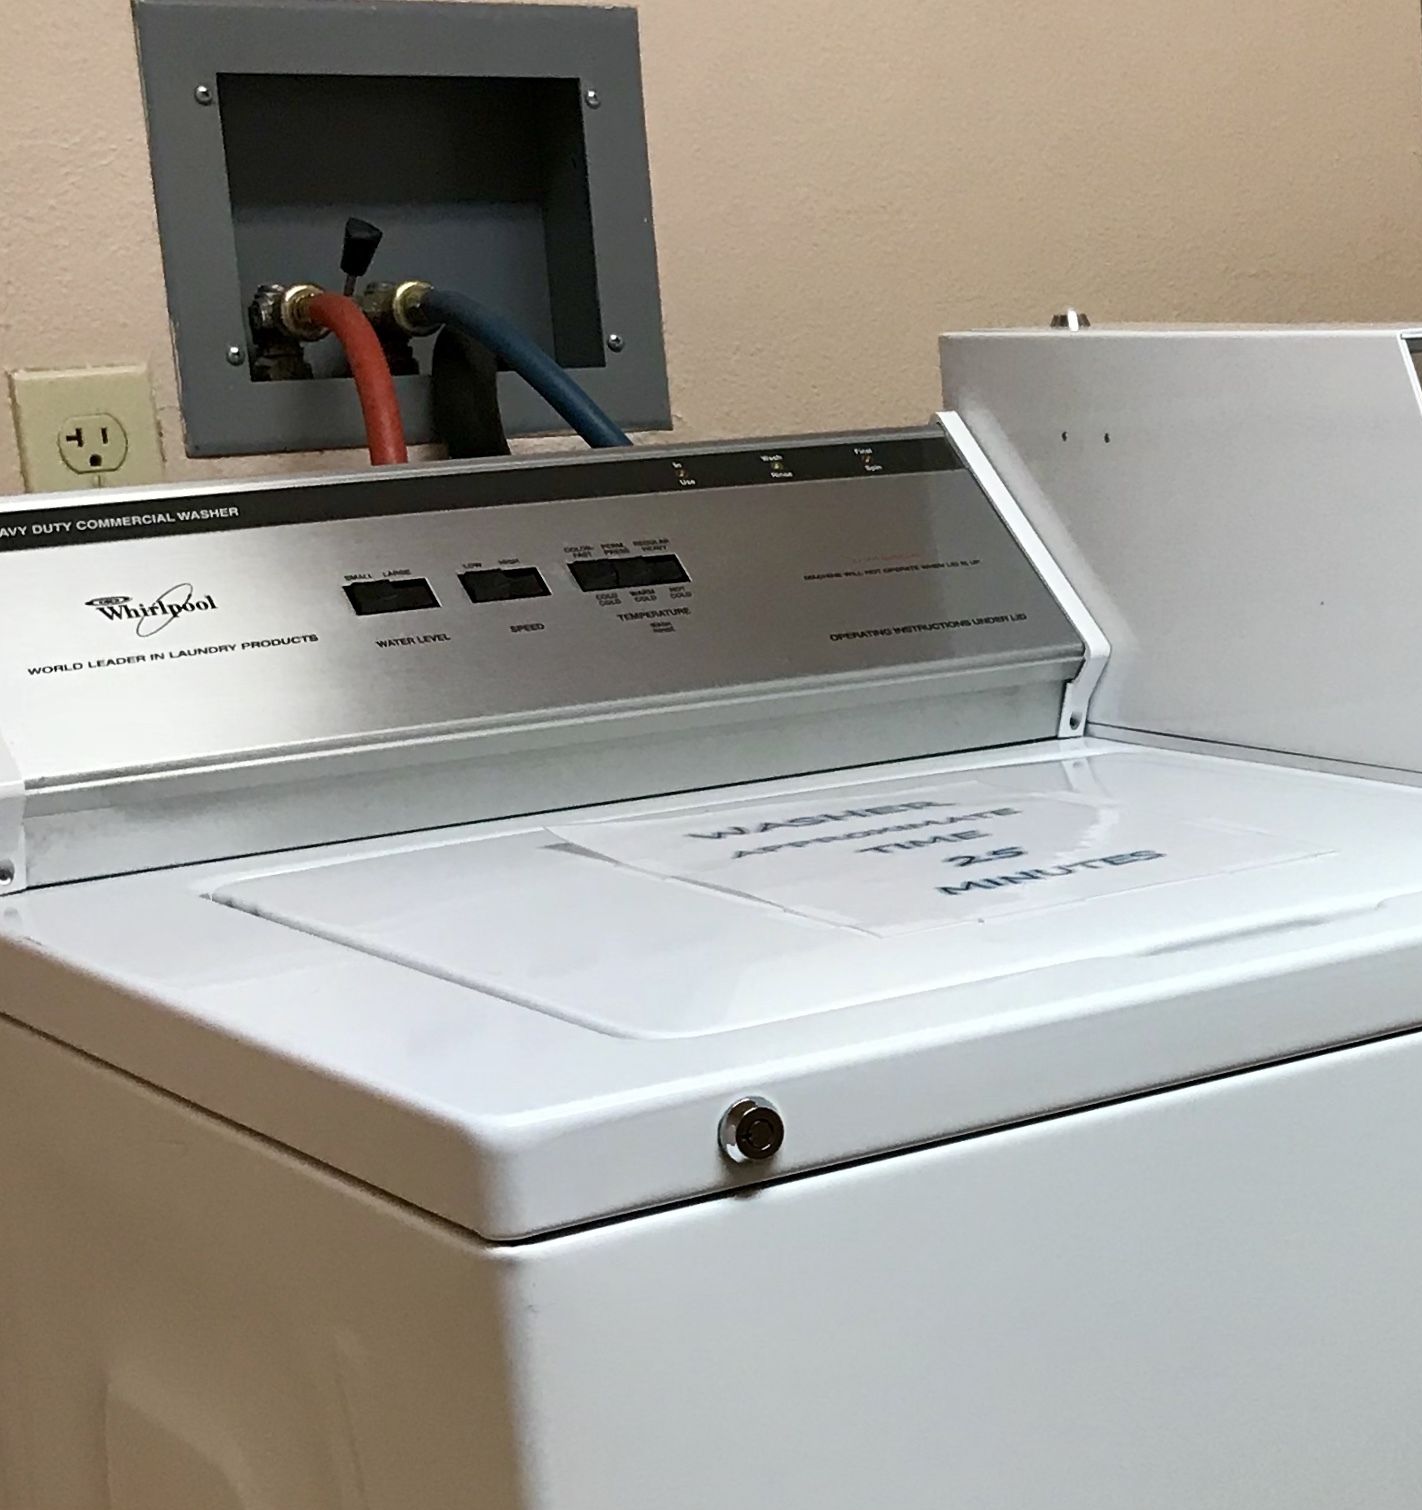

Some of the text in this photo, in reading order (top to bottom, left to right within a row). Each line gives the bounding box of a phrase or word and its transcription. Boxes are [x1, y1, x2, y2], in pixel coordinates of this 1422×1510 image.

[32, 521, 72, 535] DUTY
[77, 513, 175, 531] COMMERCIAL
[177, 507, 239, 523] WASHER
[96, 594, 218, 621] Whirlpool
[617, 607, 691, 621] TEMPERATURE
[510, 623, 545, 633] SPEED
[829, 612, 1027, 642] OPERATING INSTRUCTIONS UNDER LID
[376, 633, 451, 649] WATER LEVEL
[27, 634, 319, 676] WORLD LEADER IN LAUNDRY PRODUCTS
[686, 800, 959, 841] WASHER
[731, 806, 1024, 860] APPROXIMATE
[855, 829, 994, 855] TIME
[942, 845, 1029, 868] 25
[934, 849, 1167, 896] MINUTES
